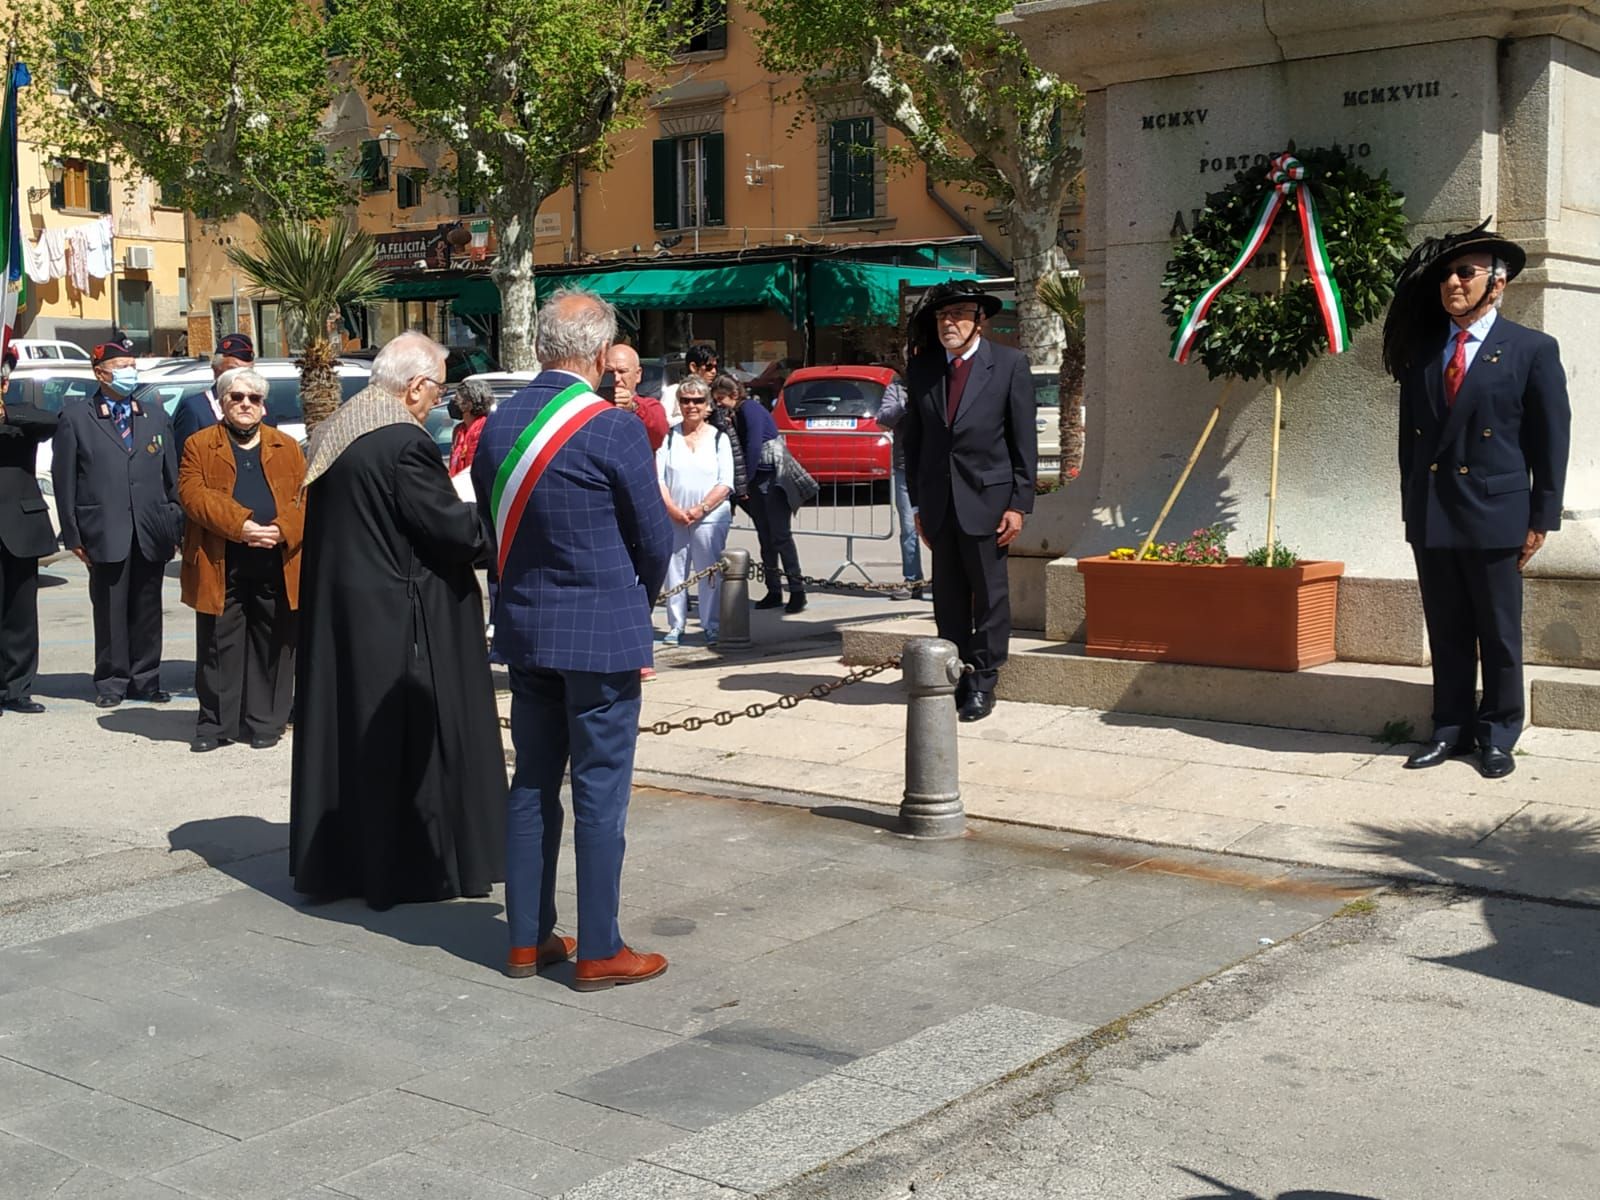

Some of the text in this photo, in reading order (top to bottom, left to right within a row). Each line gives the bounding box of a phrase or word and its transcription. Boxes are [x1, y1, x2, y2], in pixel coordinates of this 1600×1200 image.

[1343, 80, 1440, 108] MCMXVIII
[1142, 108, 1208, 130] MCMXV
[388, 236, 426, 254] FELICITÀ
